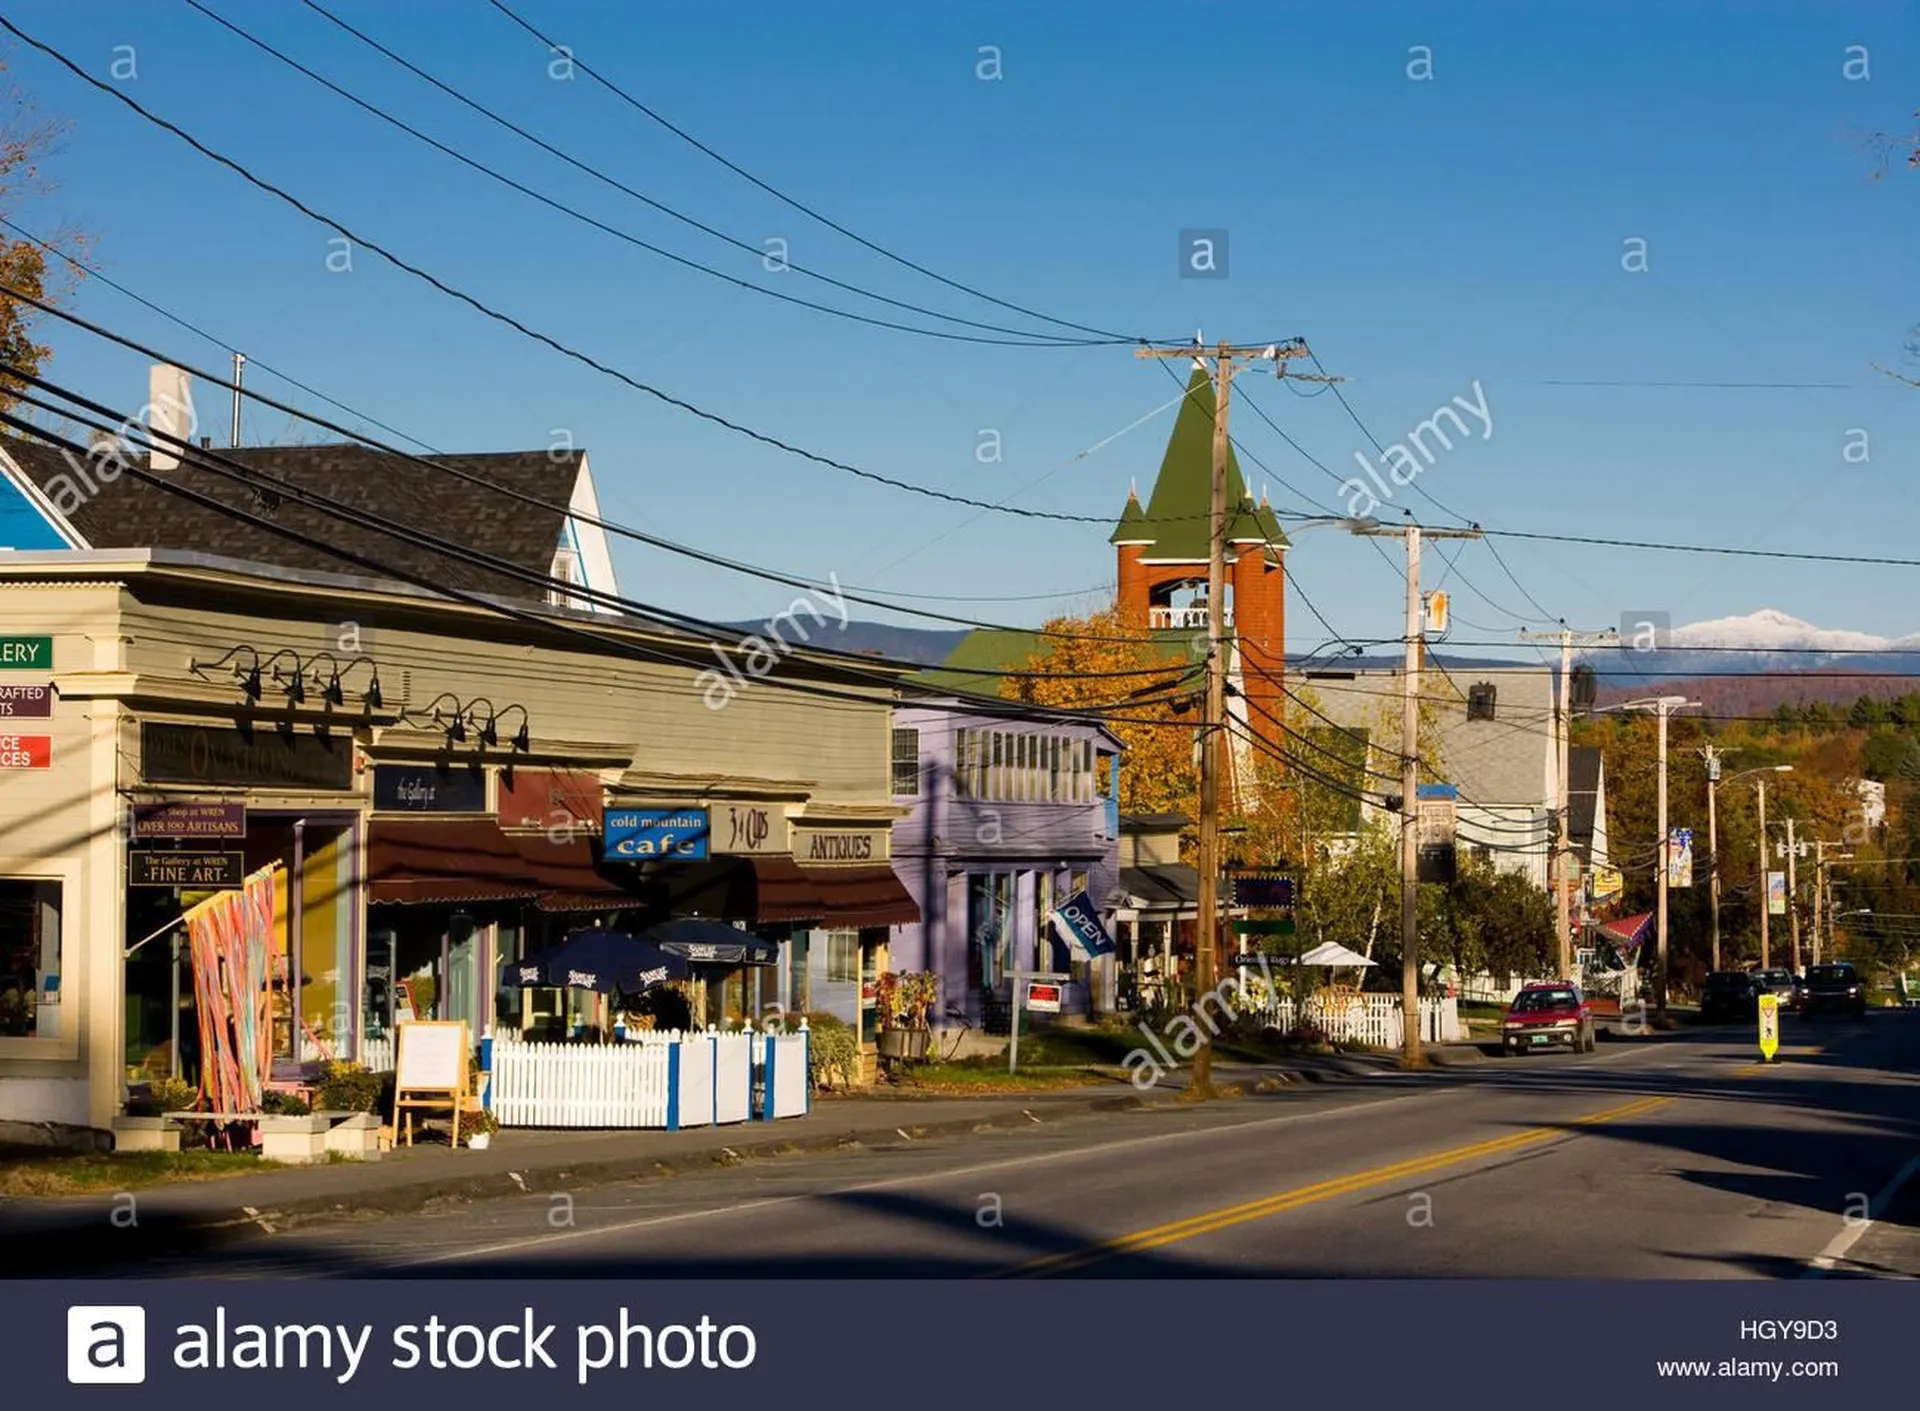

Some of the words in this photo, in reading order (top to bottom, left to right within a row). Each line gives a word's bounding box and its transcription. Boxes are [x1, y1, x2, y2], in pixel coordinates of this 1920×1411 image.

[137, 821, 165, 832] OVER
[187, 821, 239, 833] ARTISANS
[610, 815, 637, 828] cold
[641, 815, 702, 828] mountain
[617, 833, 695, 855] cafe
[810, 834, 872, 860] ANTIQUES
[150, 867, 187, 881] FINE
[192, 867, 224, 882] ART
[1063, 906, 1107, 946] OPEN
